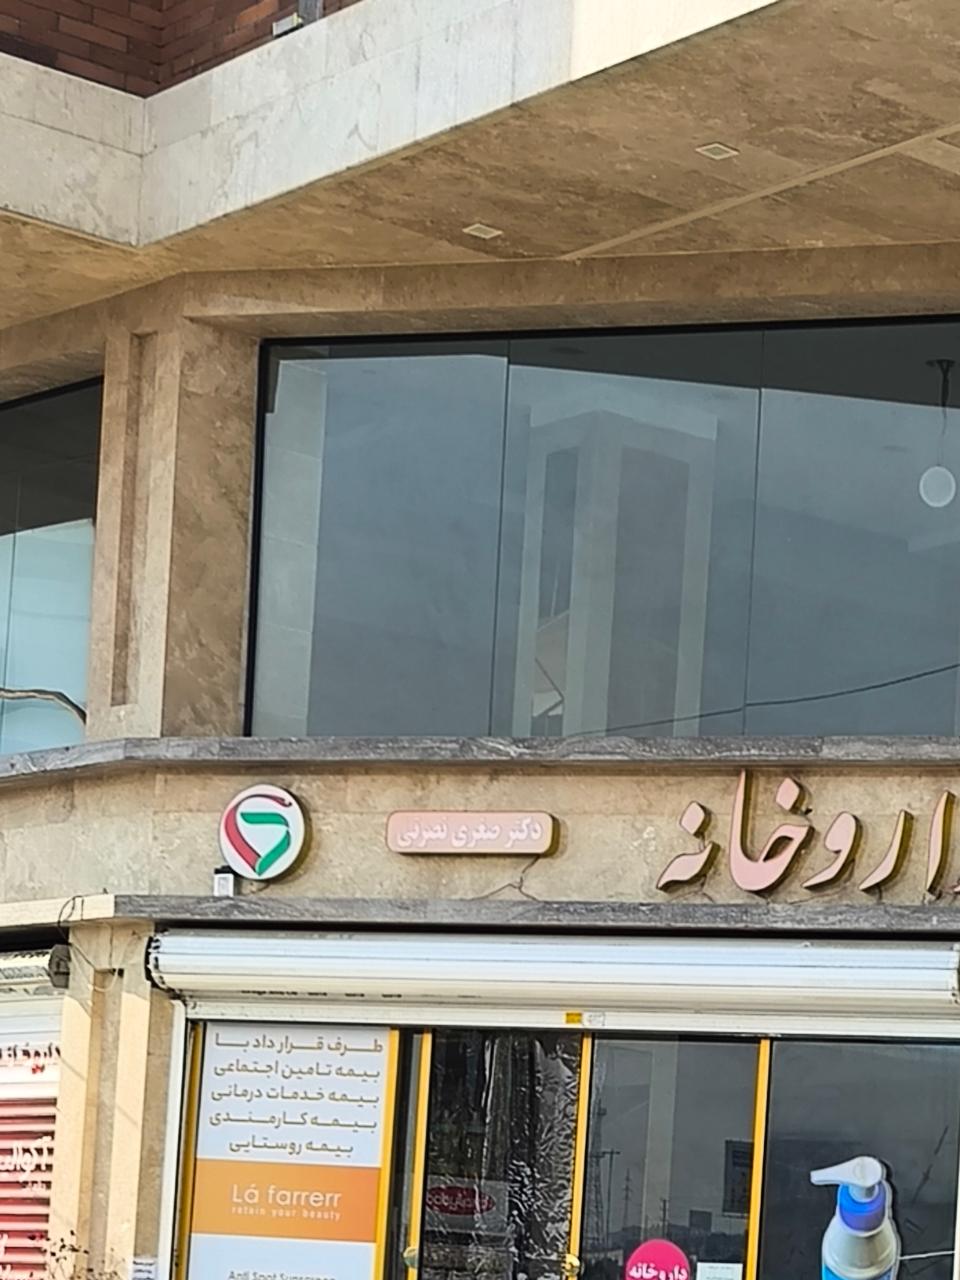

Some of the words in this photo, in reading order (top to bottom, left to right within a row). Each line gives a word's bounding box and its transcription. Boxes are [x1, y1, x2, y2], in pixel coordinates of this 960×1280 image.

[504, 816, 543, 848] دکتر
[215, 1033, 249, 1052] با
[327, 1038, 383, 1056] طرف
[214, 1059, 279, 1078] اجتماعی
[281, 1062, 332, 1080] تامین
[335, 1067, 381, 1083] بیمه
[211, 1084, 263, 1102] درمانی
[266, 1086, 325, 1102] خدمات
[328, 1091, 380, 1109] بیمه
[209, 1111, 307, 1130] کارمندی
[310, 1117, 378, 1134] بیمه
[229, 1135, 303, 1156] روستایی
[305, 1141, 354, 1158] بیمه
[267, 1184, 342, 1208] farrerr
